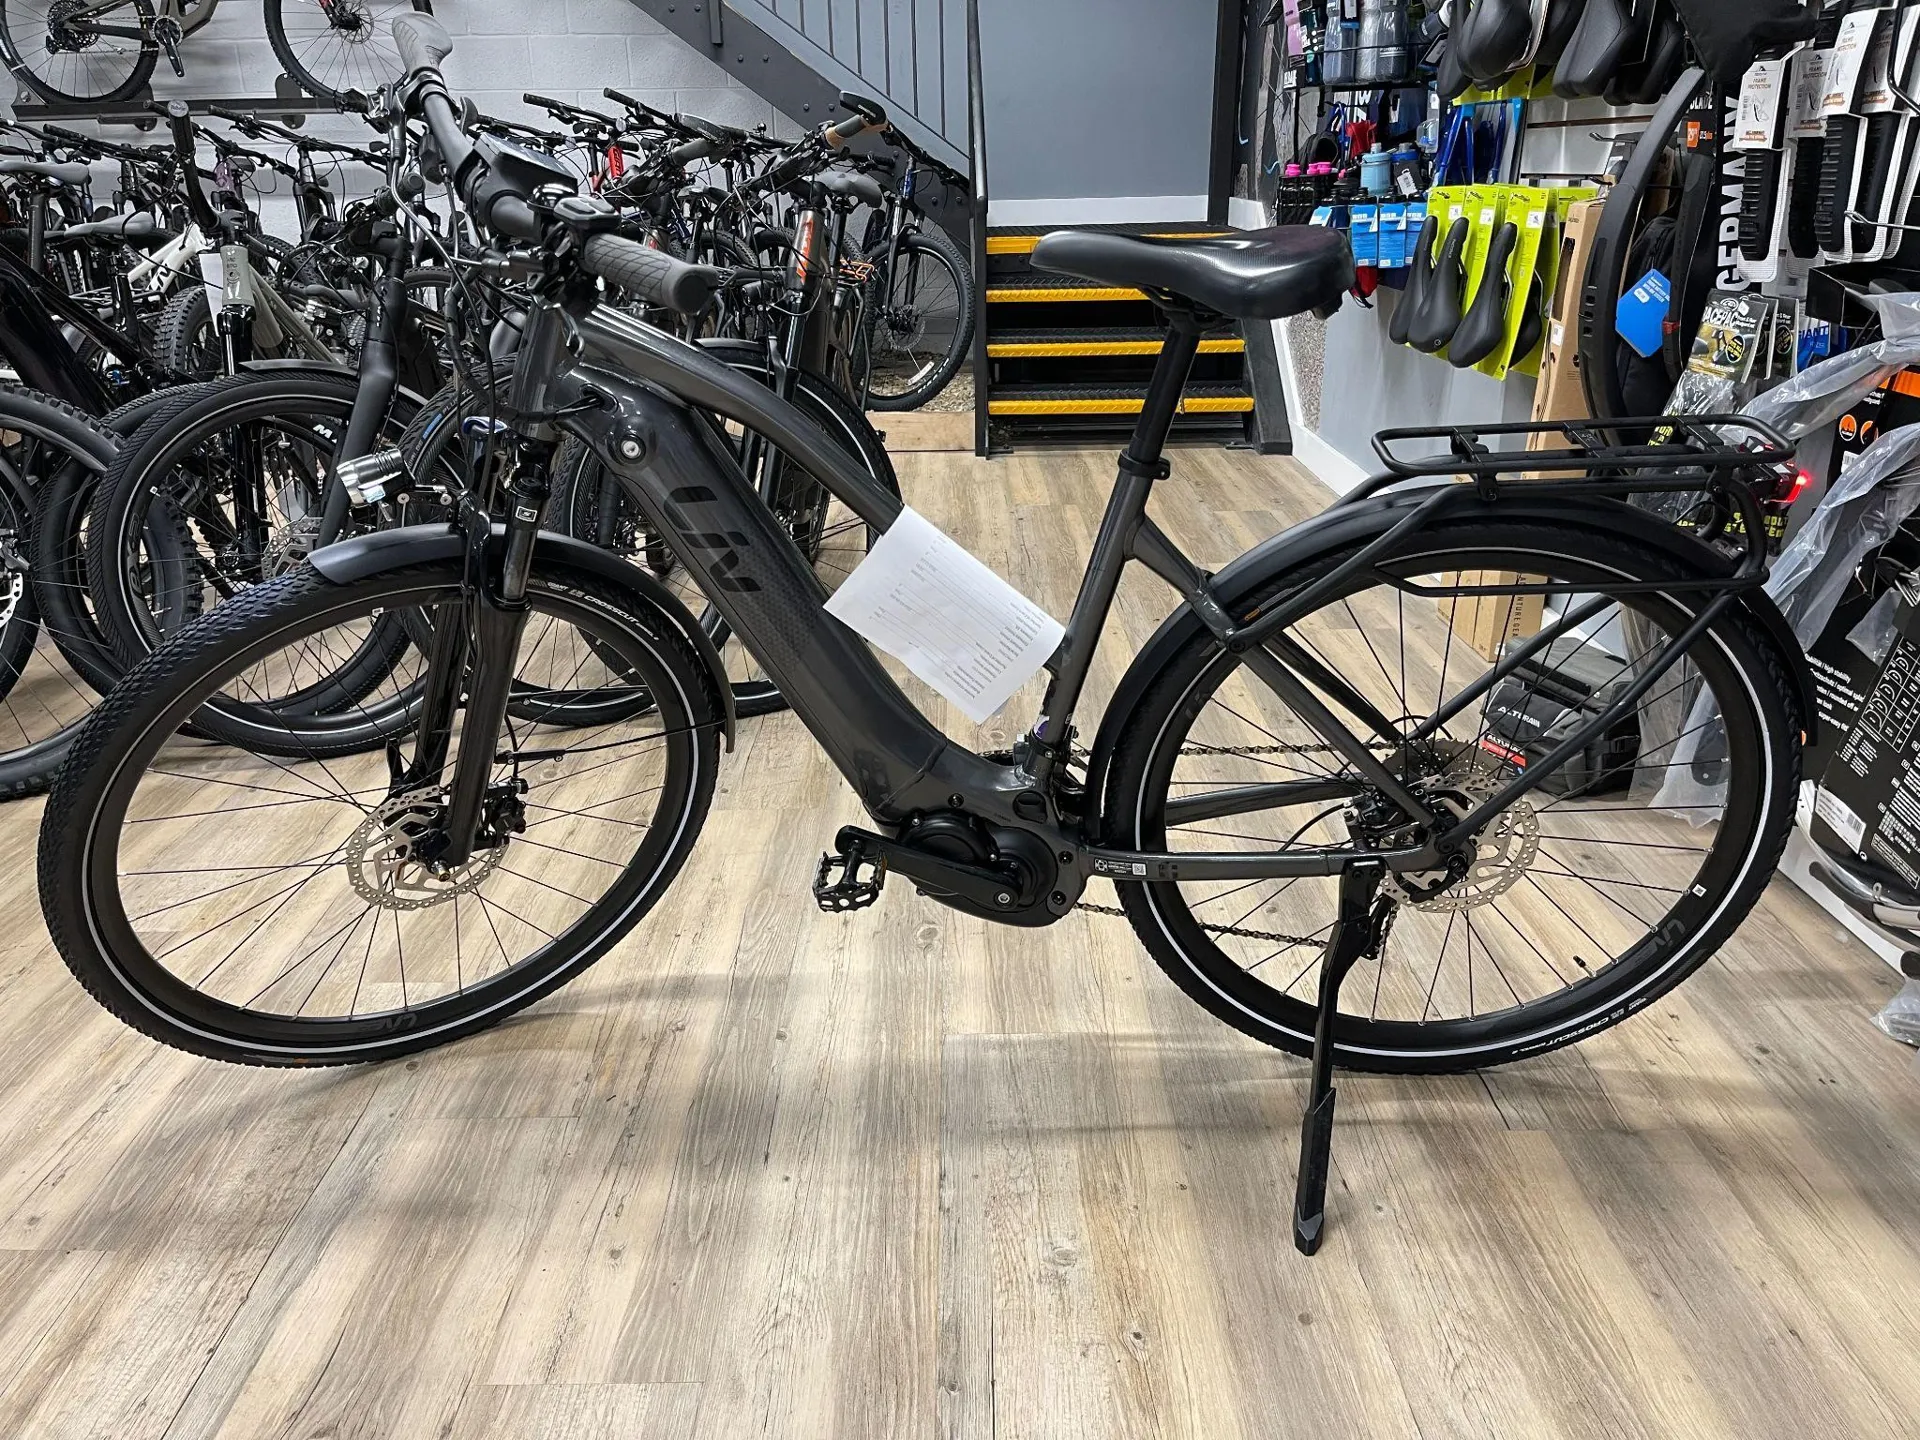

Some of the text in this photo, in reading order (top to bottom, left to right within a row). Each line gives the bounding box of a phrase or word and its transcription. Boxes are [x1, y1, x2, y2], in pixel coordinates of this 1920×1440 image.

[584, 595, 640, 623] CROSSCUT
[1498, 706, 1537, 728] ALTURA
[1546, 1018, 1610, 1047] CROSSCUT
